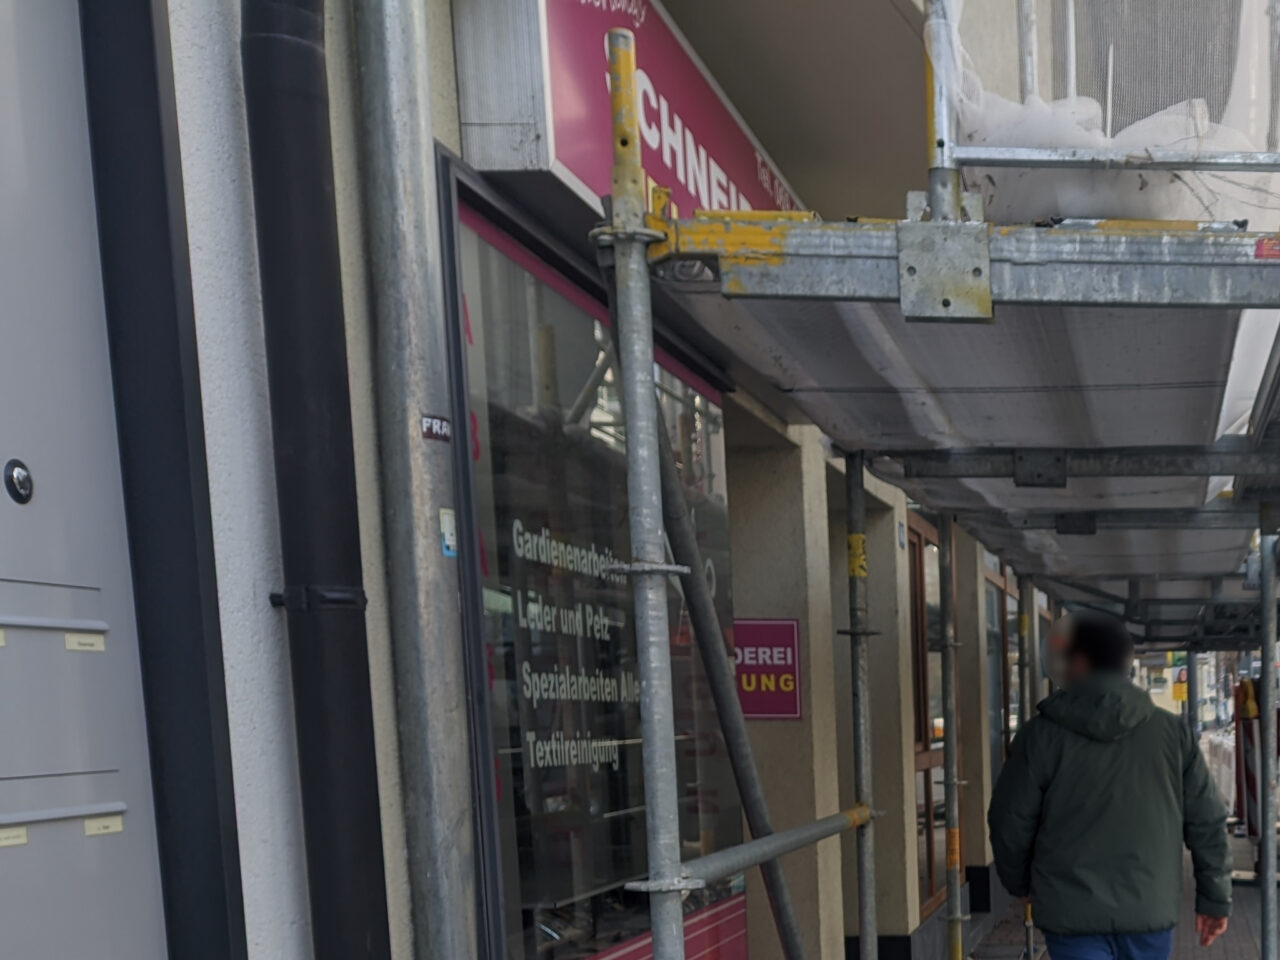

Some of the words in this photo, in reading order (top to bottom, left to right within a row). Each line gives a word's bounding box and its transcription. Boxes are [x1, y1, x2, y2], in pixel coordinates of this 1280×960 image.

[517, 589, 556, 633] Leder
[560, 603, 584, 637] und
[585, 604, 610, 641] Pelz
[522, 661, 618, 709] Spezialarbeiten
[526, 730, 619, 773] Textilreinigung
